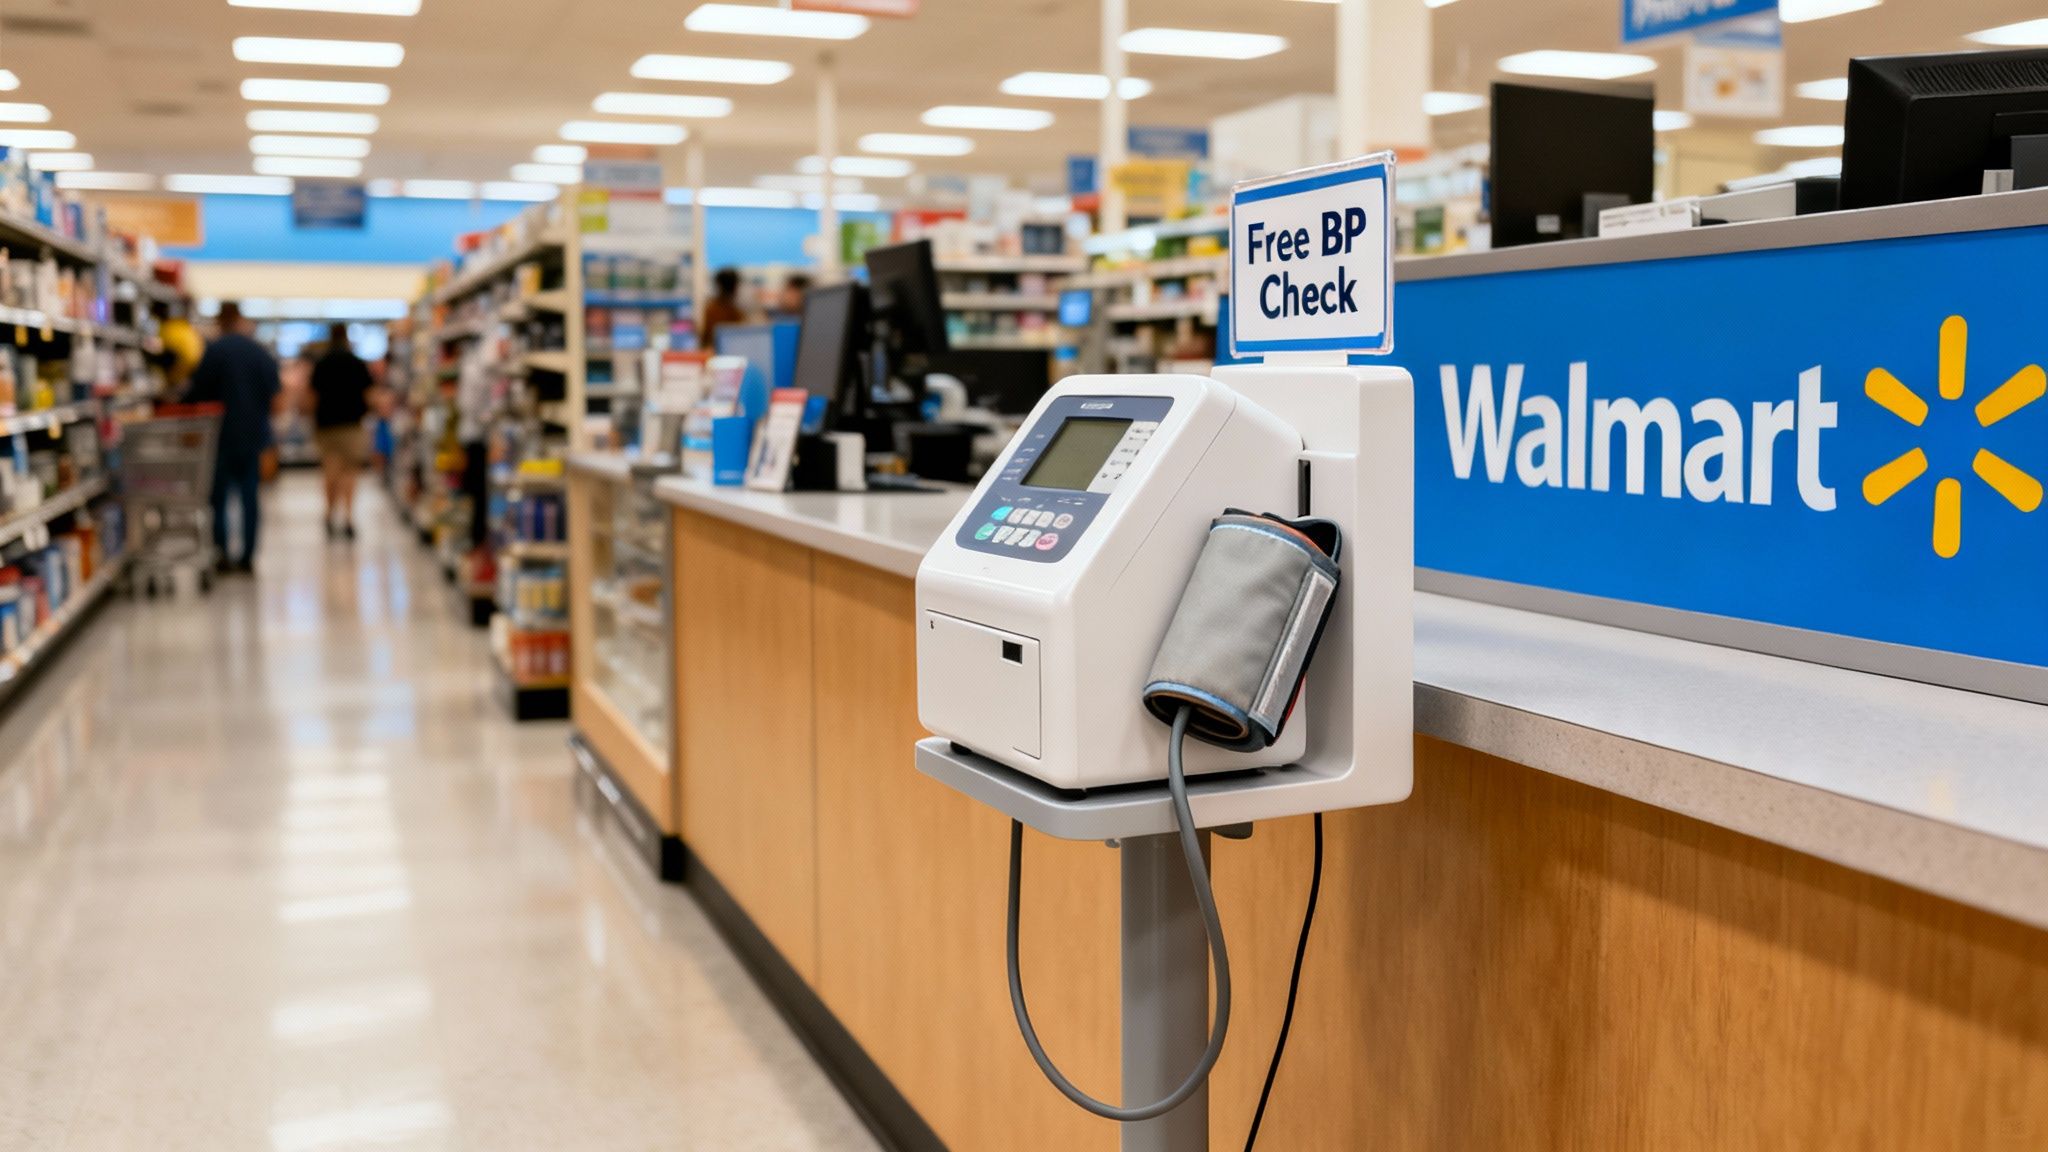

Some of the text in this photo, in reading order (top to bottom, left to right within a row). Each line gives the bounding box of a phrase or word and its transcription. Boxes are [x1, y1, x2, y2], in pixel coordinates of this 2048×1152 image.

[1248, 206, 1367, 265] Free BP
[1259, 265, 1358, 320] Check
[1439, 361, 1839, 512] Walmart
